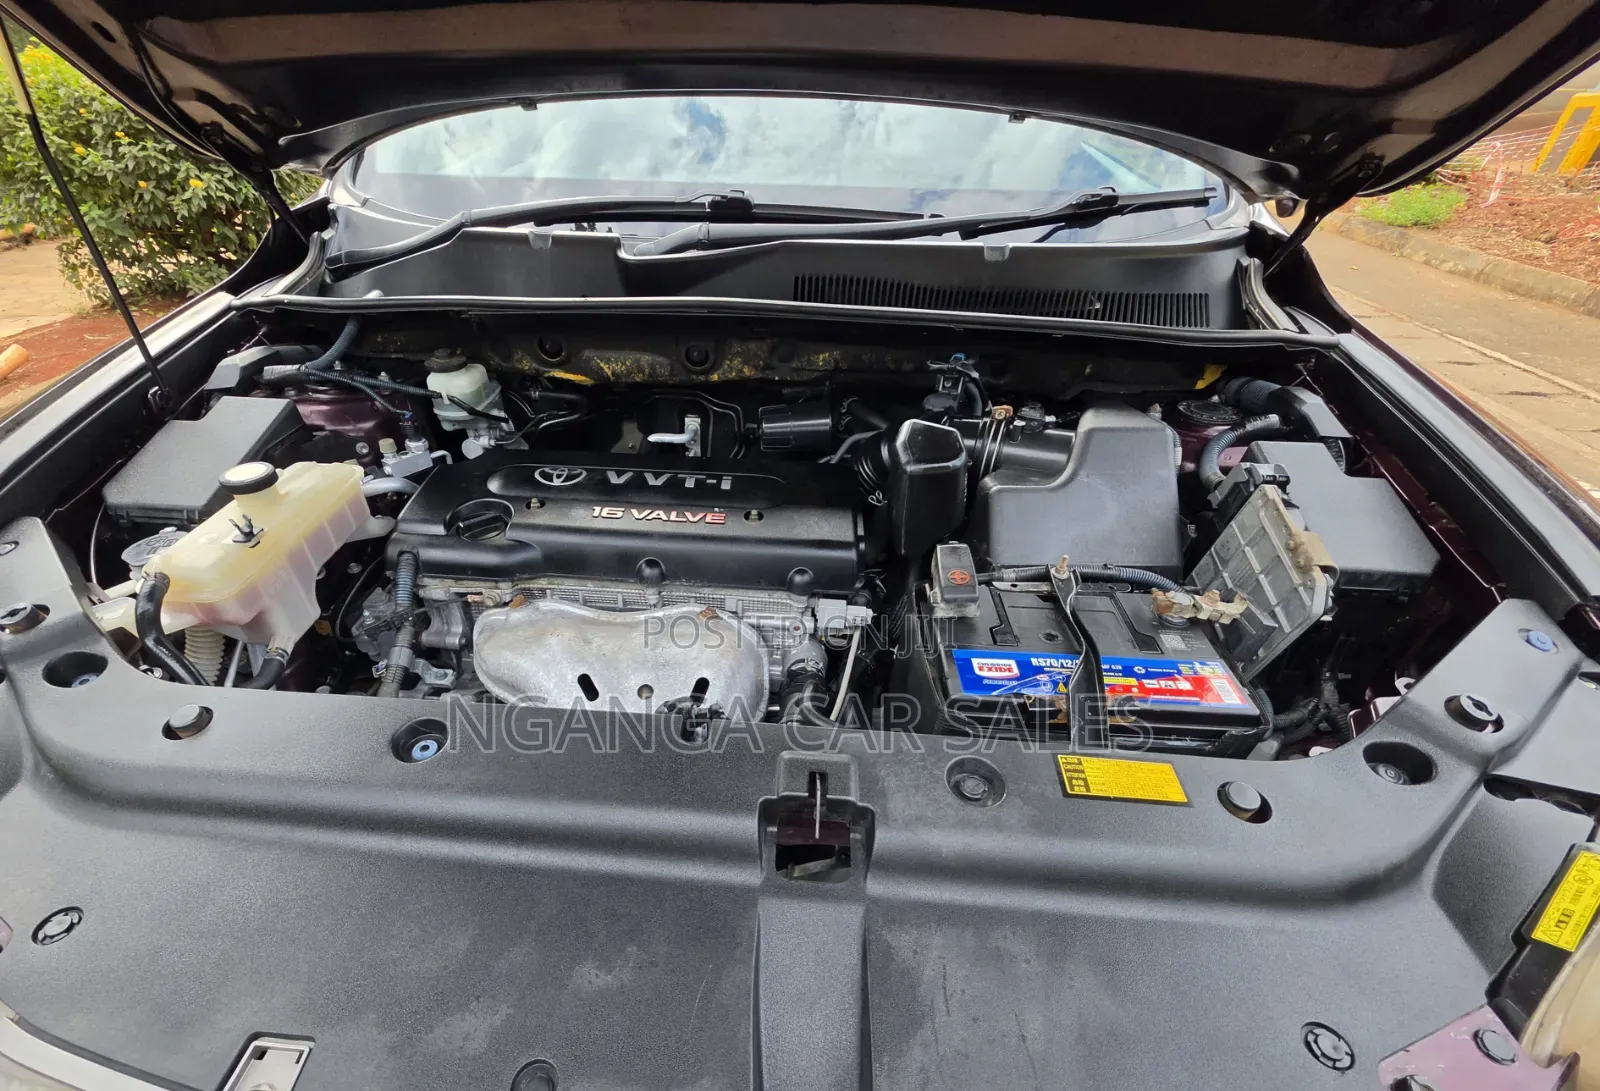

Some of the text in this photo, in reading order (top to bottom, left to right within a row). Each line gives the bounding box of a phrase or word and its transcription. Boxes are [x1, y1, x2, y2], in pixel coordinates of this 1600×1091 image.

[606, 470, 732, 490] VVT-i
[592, 506, 728, 525] 16 VALVE
[976, 666, 1015, 674] EXIDE
